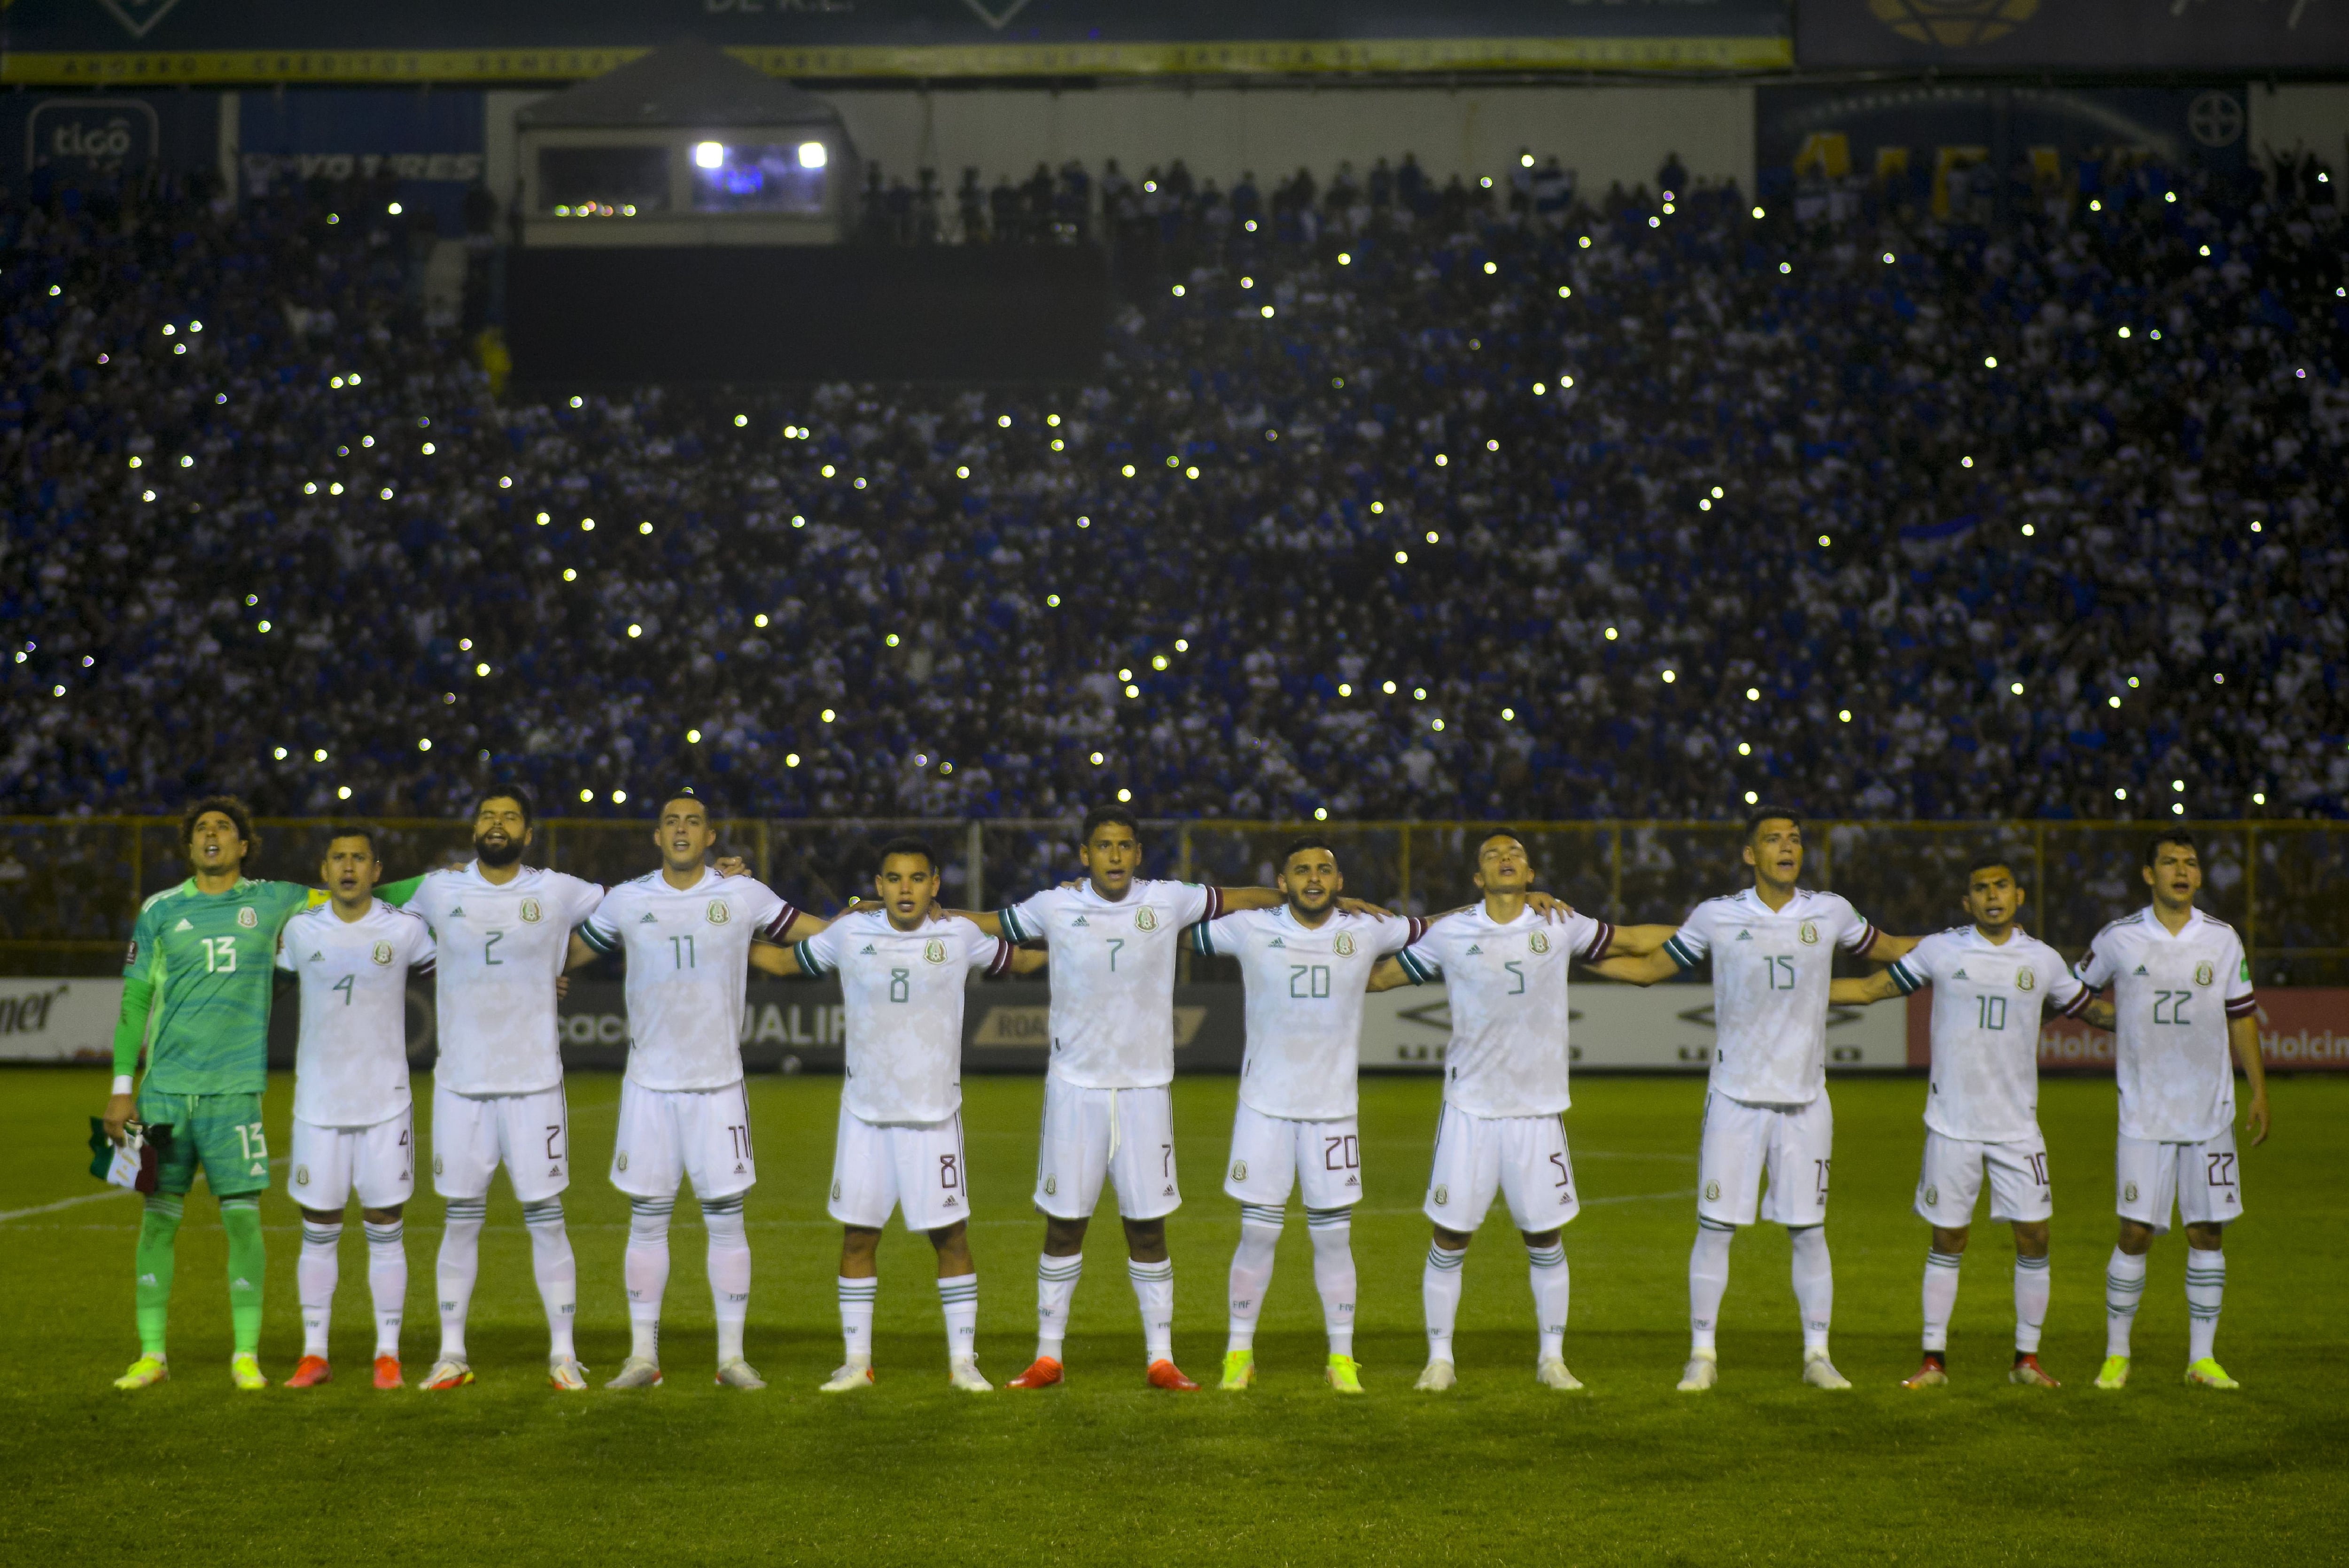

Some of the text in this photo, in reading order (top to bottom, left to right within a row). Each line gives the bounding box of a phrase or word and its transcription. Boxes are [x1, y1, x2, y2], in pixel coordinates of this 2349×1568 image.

[202, 936, 236, 972] 13
[485, 931, 504, 965] 2
[669, 935, 695, 970] 11
[1106, 939, 1124, 972] 7
[890, 968, 910, 1003] 8
[1291, 964, 1330, 998] 20
[1504, 961, 1525, 994] 5
[1763, 955, 1795, 990] 15
[333, 974, 356, 1006] 4
[1975, 995, 2007, 1031] 10
[2154, 990, 2192, 1025] 22
[235, 1122, 267, 1160] 13
[547, 1125, 562, 1159] 2
[729, 1125, 750, 1159] 11
[1325, 1135, 1359, 1171] 20
[940, 1154, 957, 1188] 8
[1162, 1144, 1171, 1178] 7
[1550, 1153, 1568, 1188] 5
[2208, 1153, 2235, 1186] 22
[1233, 1300, 1252, 1309] FMF
